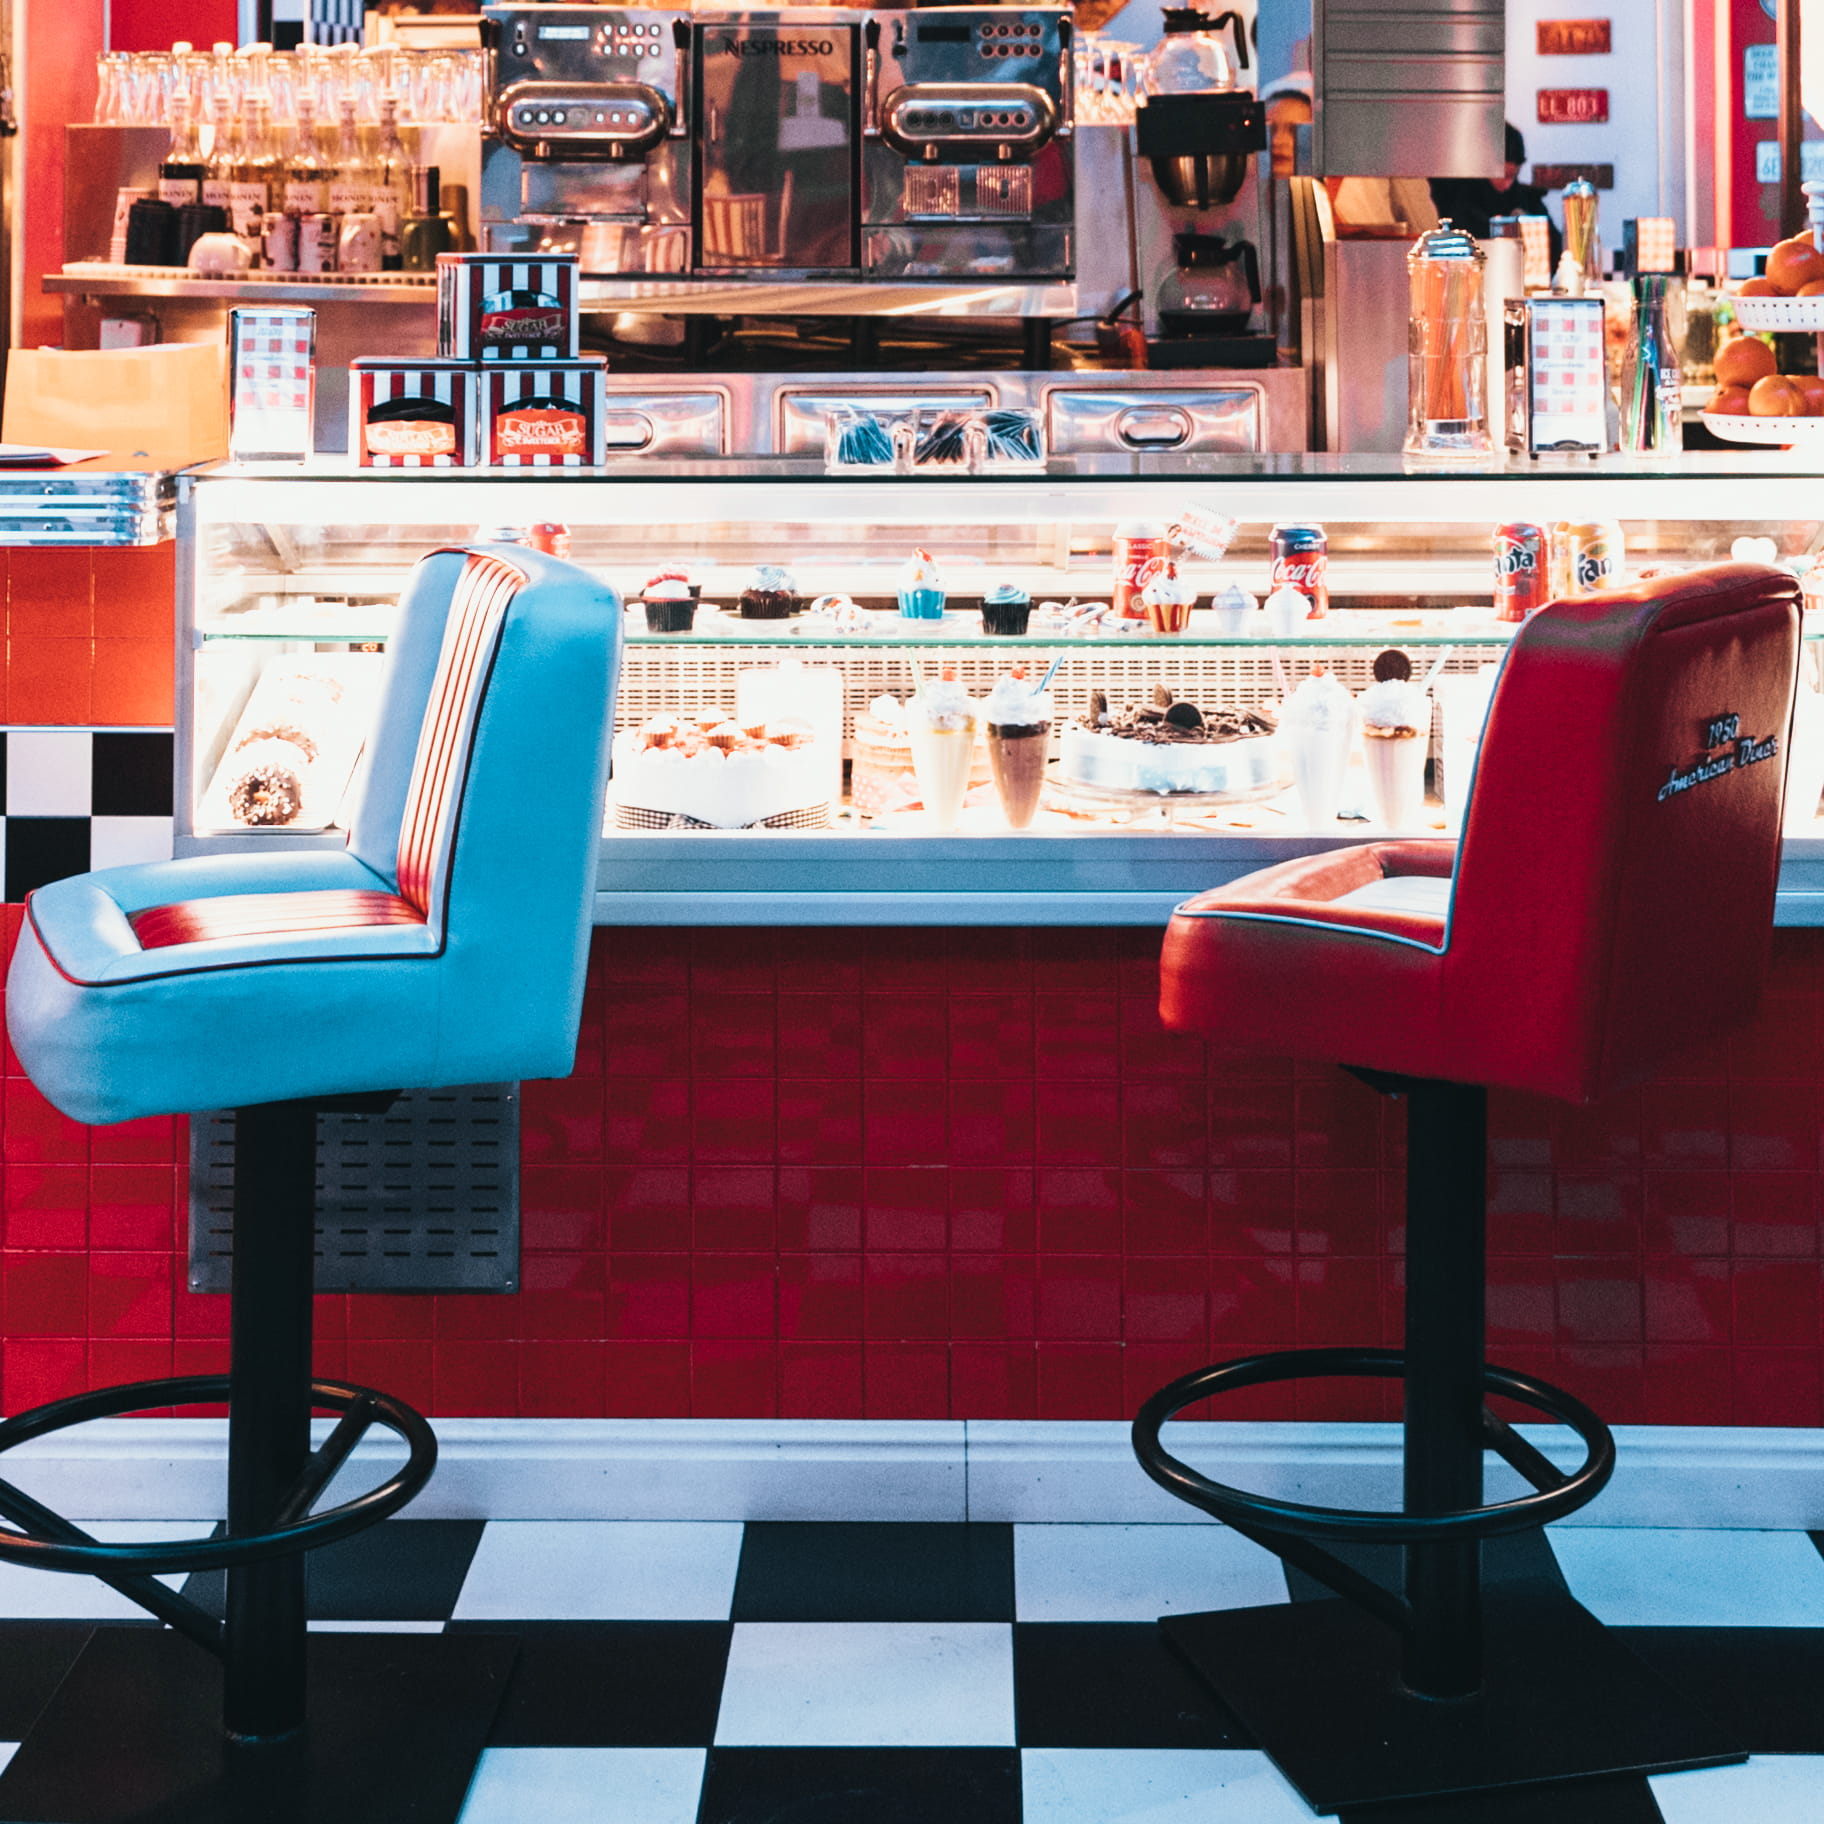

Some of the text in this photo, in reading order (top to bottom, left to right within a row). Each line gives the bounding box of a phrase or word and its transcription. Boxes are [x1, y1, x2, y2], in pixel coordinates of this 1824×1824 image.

[724, 37, 834, 58] NESPRESSO
[515, 422, 567, 438] SUGAR
[1707, 713, 1740, 749] 1950
[1657, 736, 1778, 802] American Diner
